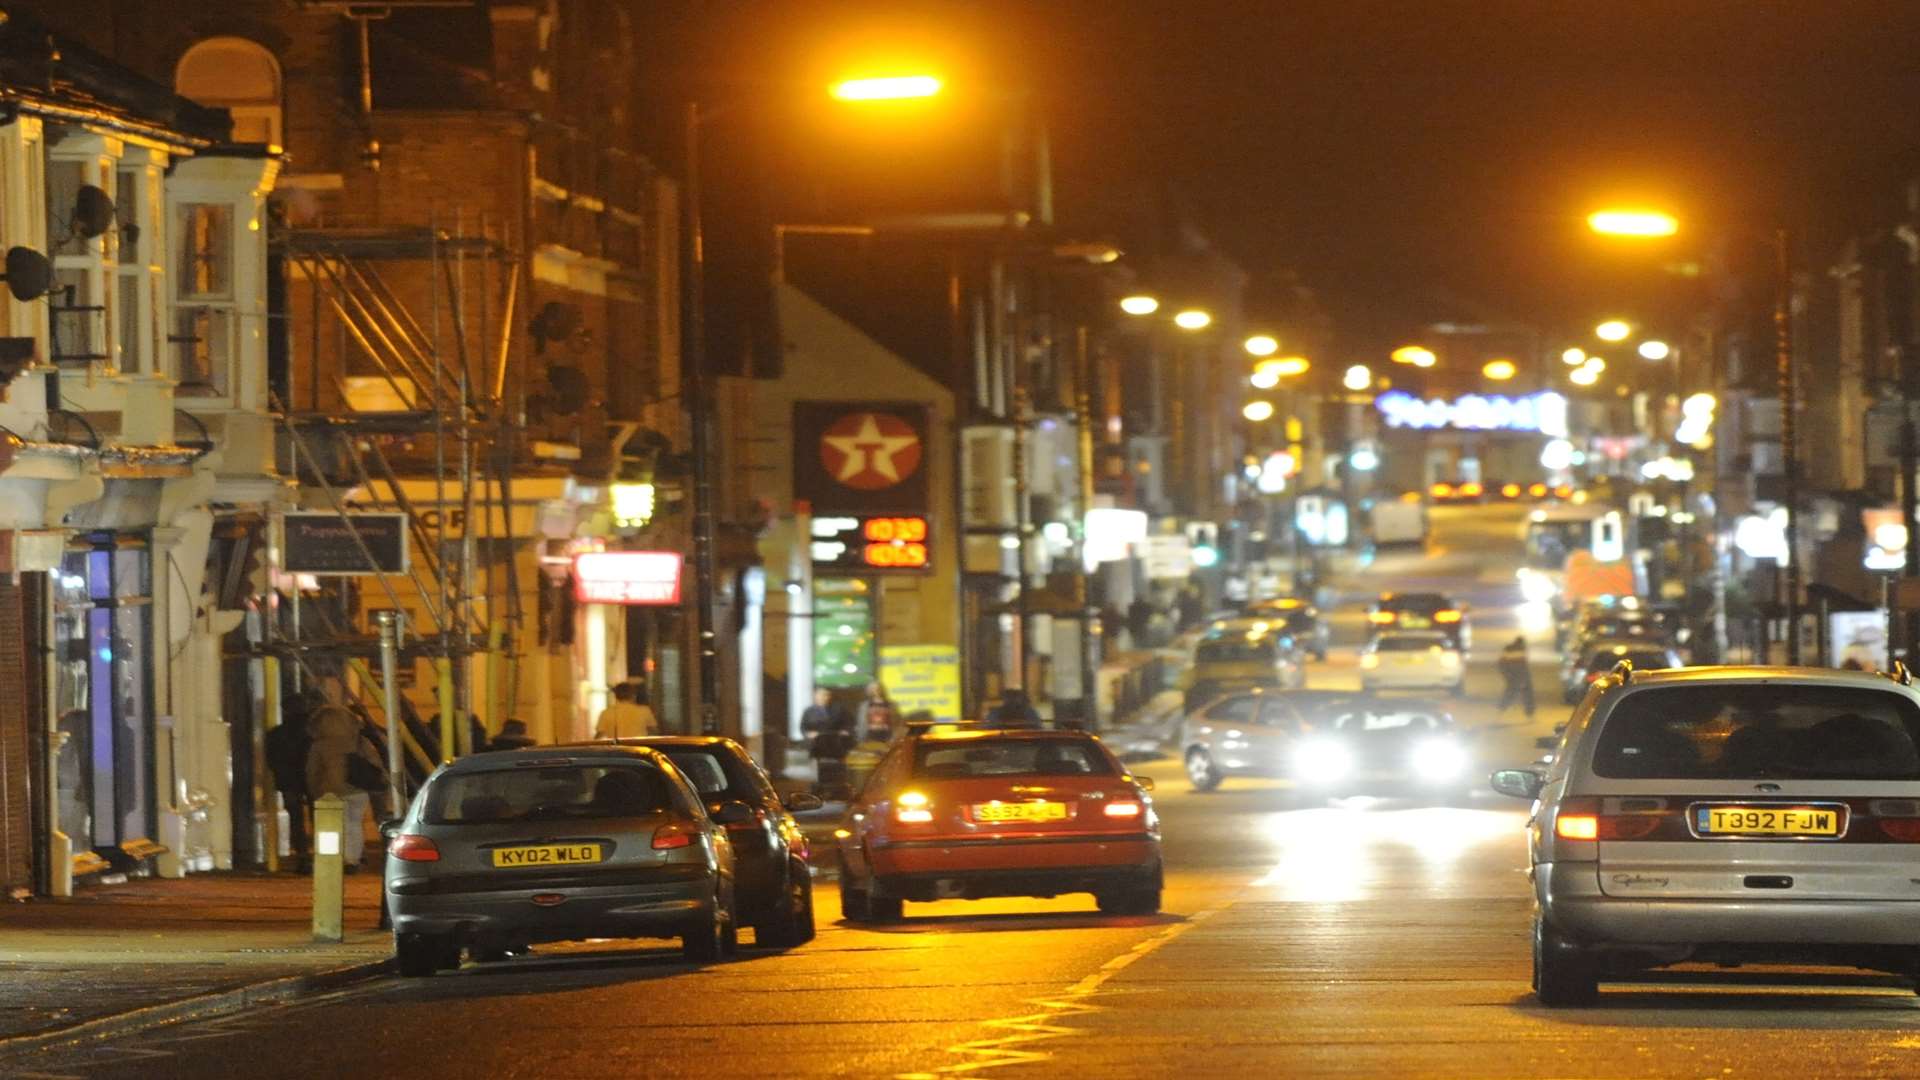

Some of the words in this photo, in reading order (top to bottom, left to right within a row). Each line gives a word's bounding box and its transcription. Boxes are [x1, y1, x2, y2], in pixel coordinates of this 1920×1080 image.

[1713, 812, 1776, 829] T392
[1783, 813, 1829, 829] FJW
[502, 849, 551, 864] KY02
